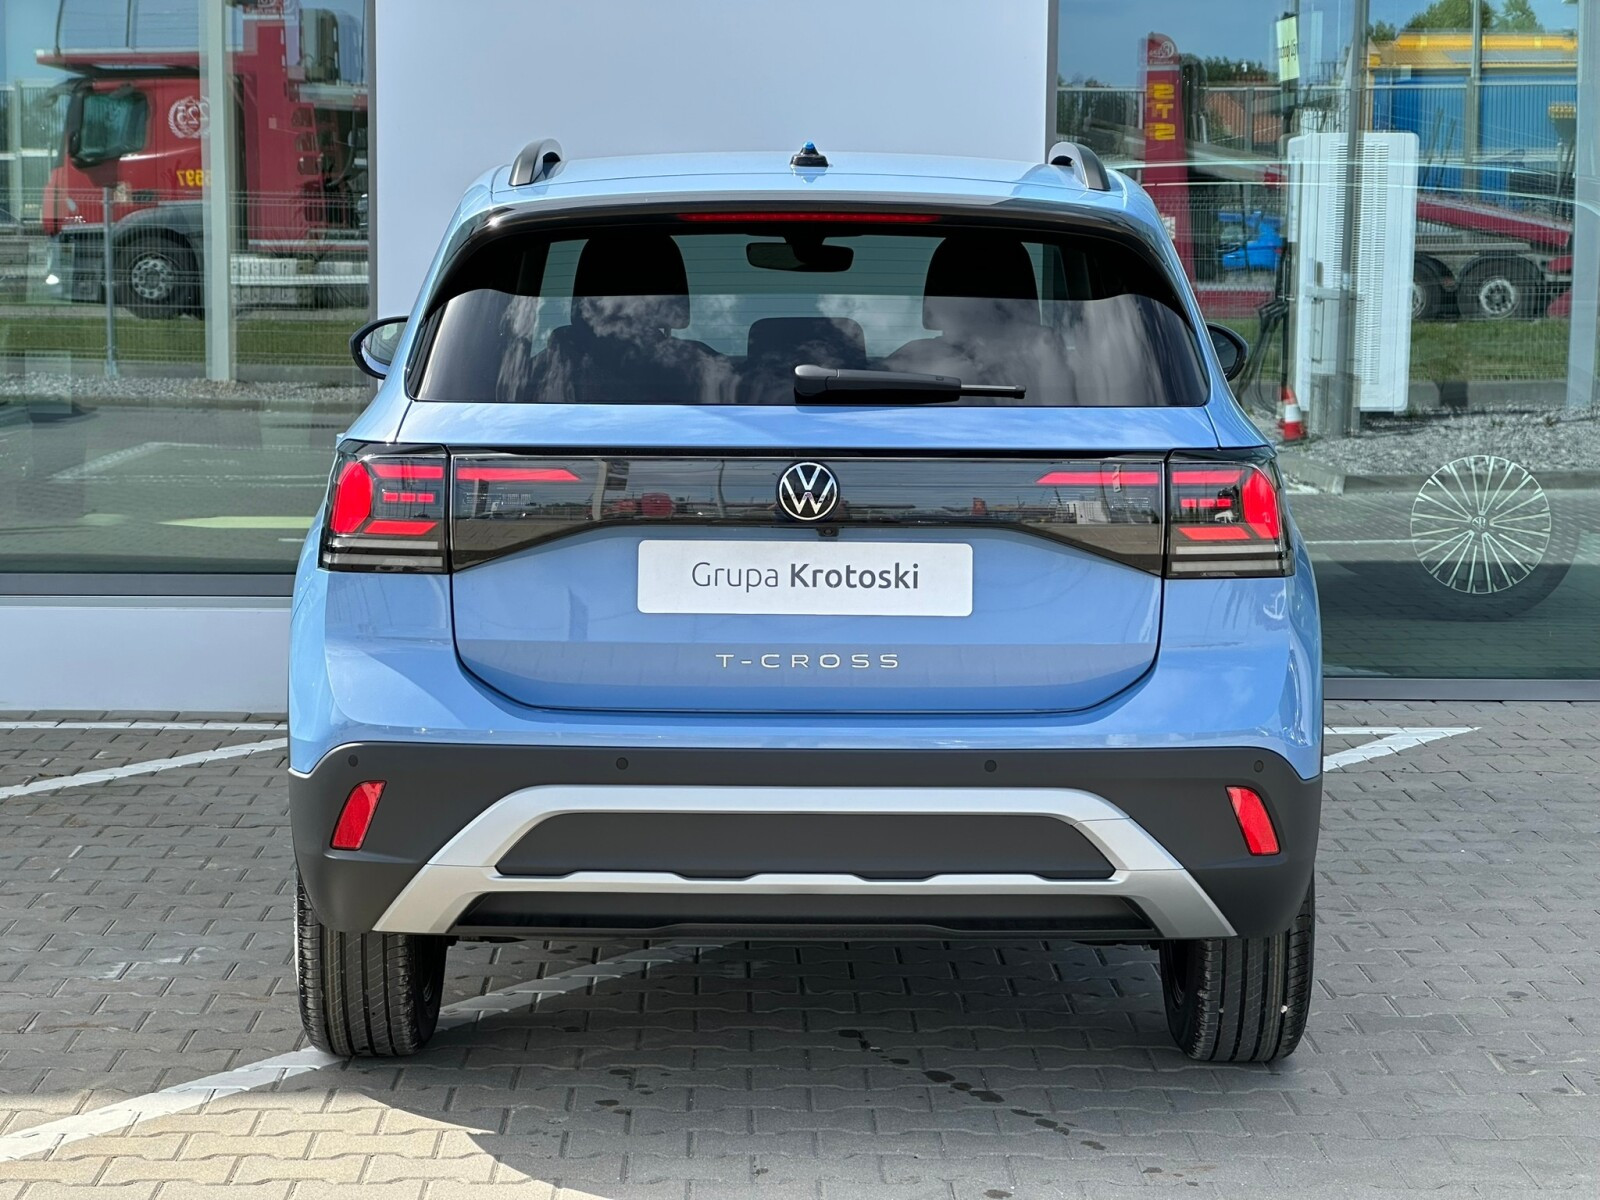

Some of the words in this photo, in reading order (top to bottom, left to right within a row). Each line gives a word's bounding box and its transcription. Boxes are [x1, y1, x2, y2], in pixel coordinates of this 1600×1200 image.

[691, 561, 779, 593] Grupa
[789, 562, 920, 590] Krotoski
[715, 653, 900, 669] T-CROSS
